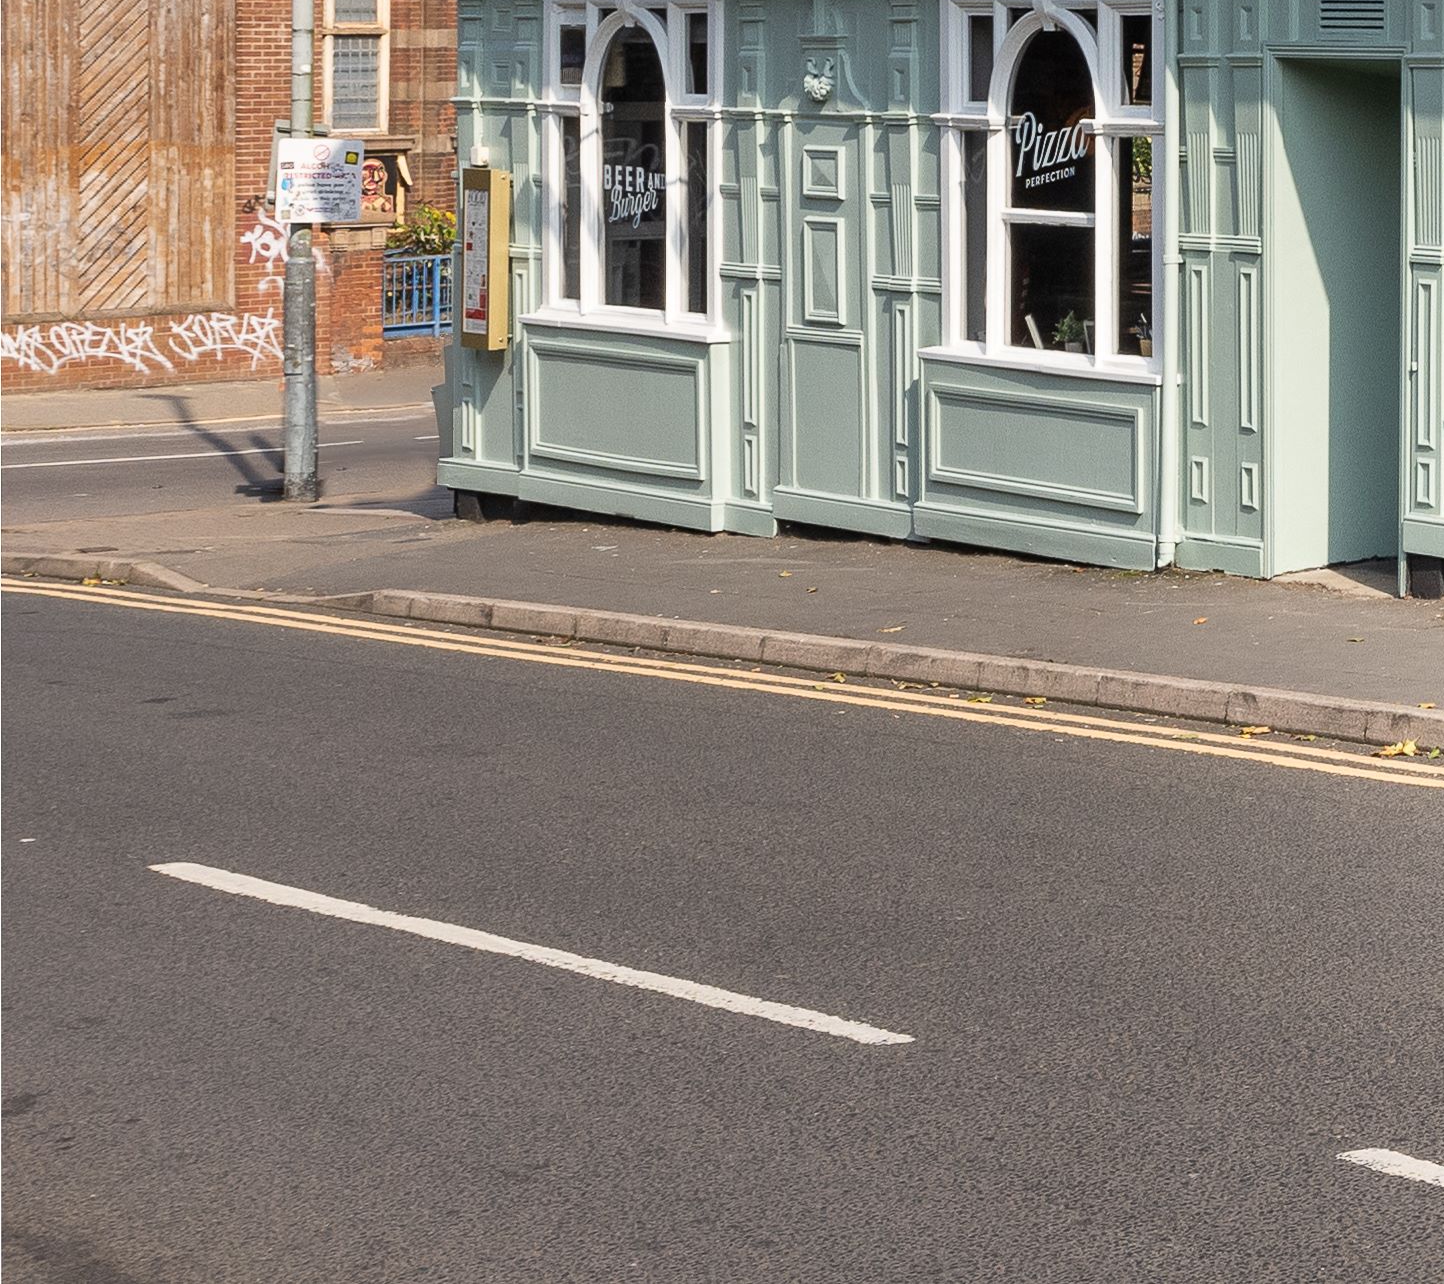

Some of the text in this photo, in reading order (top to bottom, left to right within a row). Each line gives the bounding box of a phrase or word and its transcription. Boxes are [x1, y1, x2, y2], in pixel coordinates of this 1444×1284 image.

[1015, 111, 1091, 177] Pizza
[603, 164, 645, 193] BEER
[1025, 165, 1076, 189] PERFECTION
[608, 184, 659, 229] Burger
